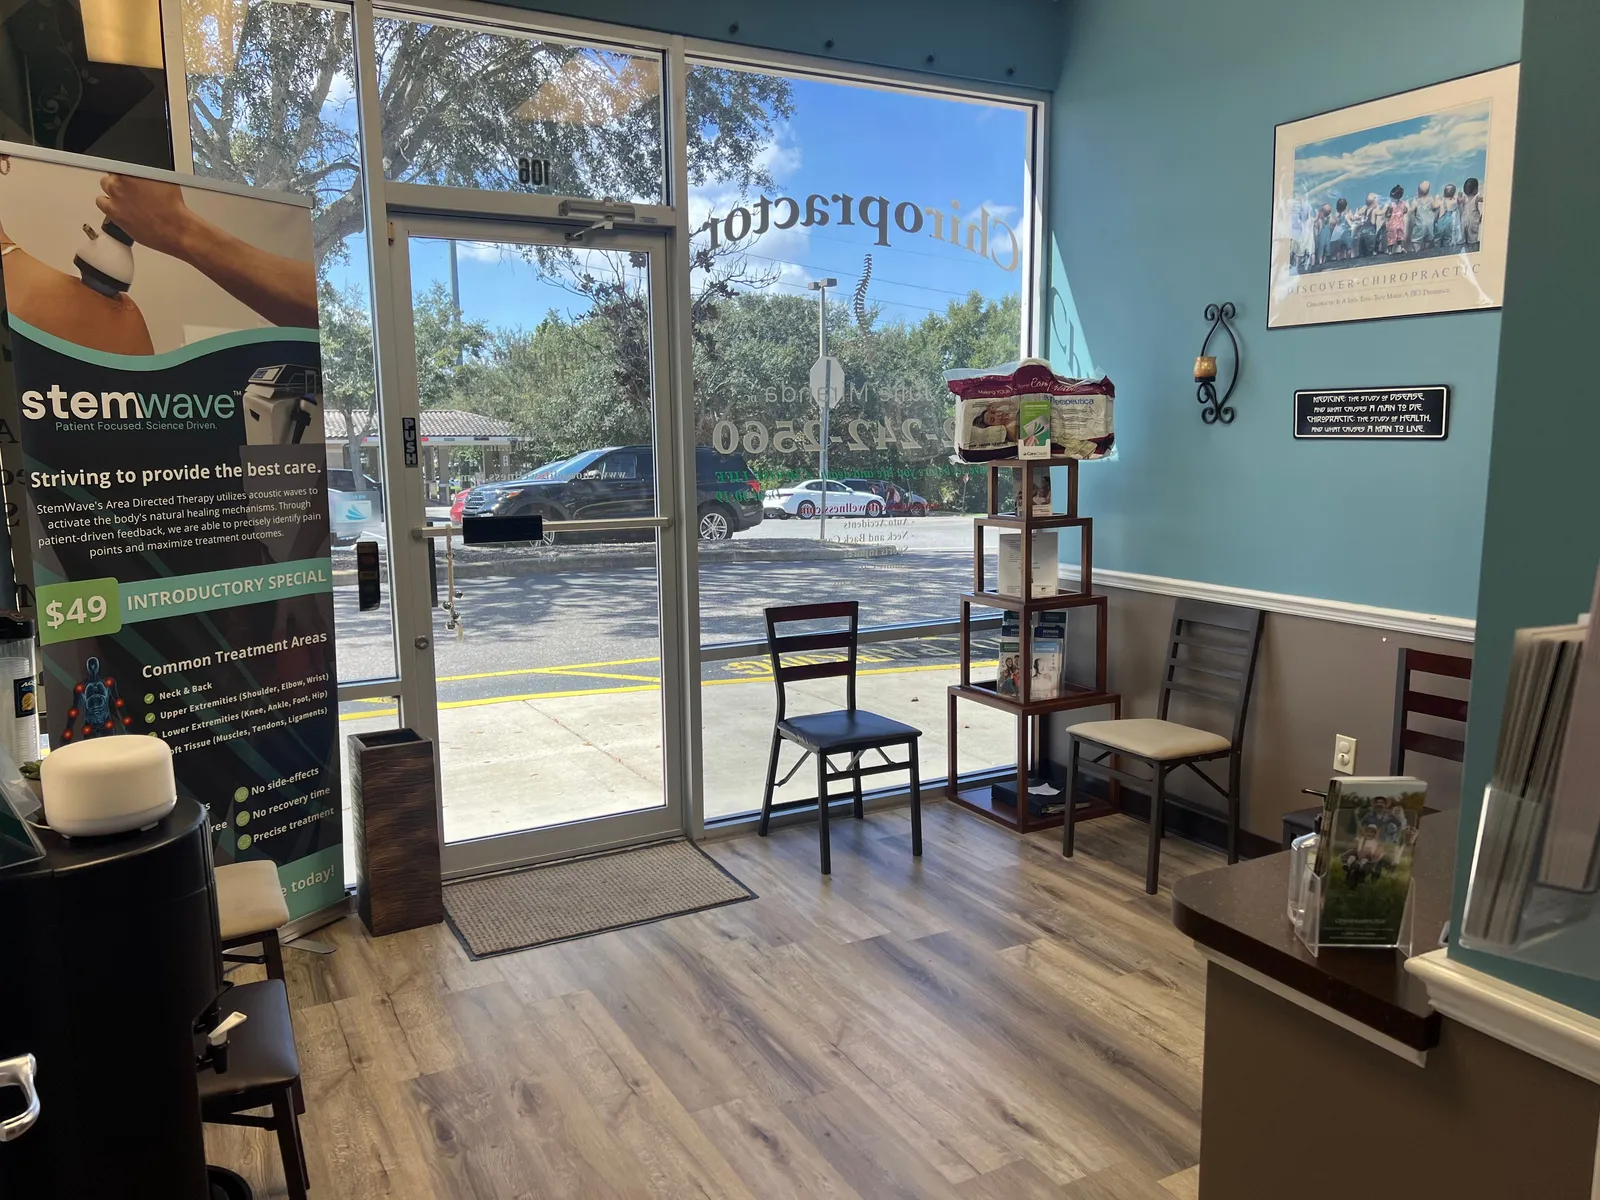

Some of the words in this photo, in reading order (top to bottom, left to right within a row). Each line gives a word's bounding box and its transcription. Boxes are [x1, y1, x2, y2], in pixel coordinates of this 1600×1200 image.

[1369, 404, 1376, 412] A
[1376, 404, 1396, 412] MAN
[1398, 404, 1406, 412] TO
[56, 421, 94, 432] Patient
[97, 421, 144, 432] Focused.
[146, 421, 184, 431] Science
[186, 421, 218, 431] Driven.
[403, 418, 418, 466] PUSH
[1367, 425, 1374, 433] A
[1394, 424, 1404, 432] TO
[30, 469, 112, 489] Striving
[116, 469, 136, 484] to
[142, 464, 210, 486] provide
[214, 462, 242, 478] the
[247, 462, 280, 477] best
[284, 462, 322, 475] care.
[36, 501, 104, 515] StemWave's
[106, 500, 130, 510] Area
[132, 496, 174, 508] Directed
[176, 494, 214, 505] Therapy
[216, 491, 247, 502] utilizes
[248, 489, 282, 500] acoustic
[284, 488, 307, 497] waves
[308, 487, 318, 495] to
[48, 518, 91, 530] activate
[94, 516, 112, 526] the
[114, 514, 148, 526] body's
[150, 510, 184, 521] natural
[186, 508, 220, 520] healing
[222, 502, 278, 516] mechanisms.
[278, 500, 312, 512] Through
[38, 531, 115, 549] patient-driven
[117, 525, 166, 538] feedback,
[168, 526, 182, 536] we
[184, 524, 199, 534] are
[201, 522, 220, 532] able
[222, 520, 232, 529] to
[234, 517, 271, 532] precisely
[272, 514, 301, 525] identify
[302, 512, 322, 523] pain
[89, 546, 123, 560] points
[125, 542, 145, 554] and
[147, 536, 193, 551] maximize
[195, 533, 240, 546] treatment
[242, 529, 284, 540] outcomes.
[127, 577, 264, 612] INTRODUCTORY
[268, 569, 327, 590] SPECIAL
[45, 594, 108, 630] $49
[142, 655, 212, 678] Common
[214, 640, 288, 664] Treatment
[290, 632, 328, 648] Areas
[159, 688, 182, 700] Neck
[184, 686, 190, 695] &
[192, 681, 213, 692] Back
[160, 707, 188, 720] Upper
[190, 694, 238, 712] Extremities
[240, 685, 280, 702] (Shoulder,
[281, 679, 306, 692] Elbow,
[306, 672, 330, 684] Wrist)
[162, 725, 190, 738] Lower
[191, 712, 240, 731] Extremities
[241, 706, 267, 720] (Knee,
[268, 700, 292, 712] Ankle,
[292, 695, 311, 706] Foot,
[312, 690, 328, 700] Hip)
[170, 745, 182, 756] oft
[184, 739, 211, 752] Tissue
[212, 728, 250, 746] (Muscles,
[252, 718, 288, 733] Tendons,
[288, 706, 328, 724] Ligaments)
[251, 784, 266, 796] No
[268, 767, 320, 790] side-effects
[252, 808, 266, 820] No
[268, 794, 308, 814] recovery
[310, 787, 330, 800] time
[210, 821, 228, 832] ree
[253, 826, 288, 842] Precise
[288, 807, 335, 830] treatment
[290, 864, 334, 892] today!
